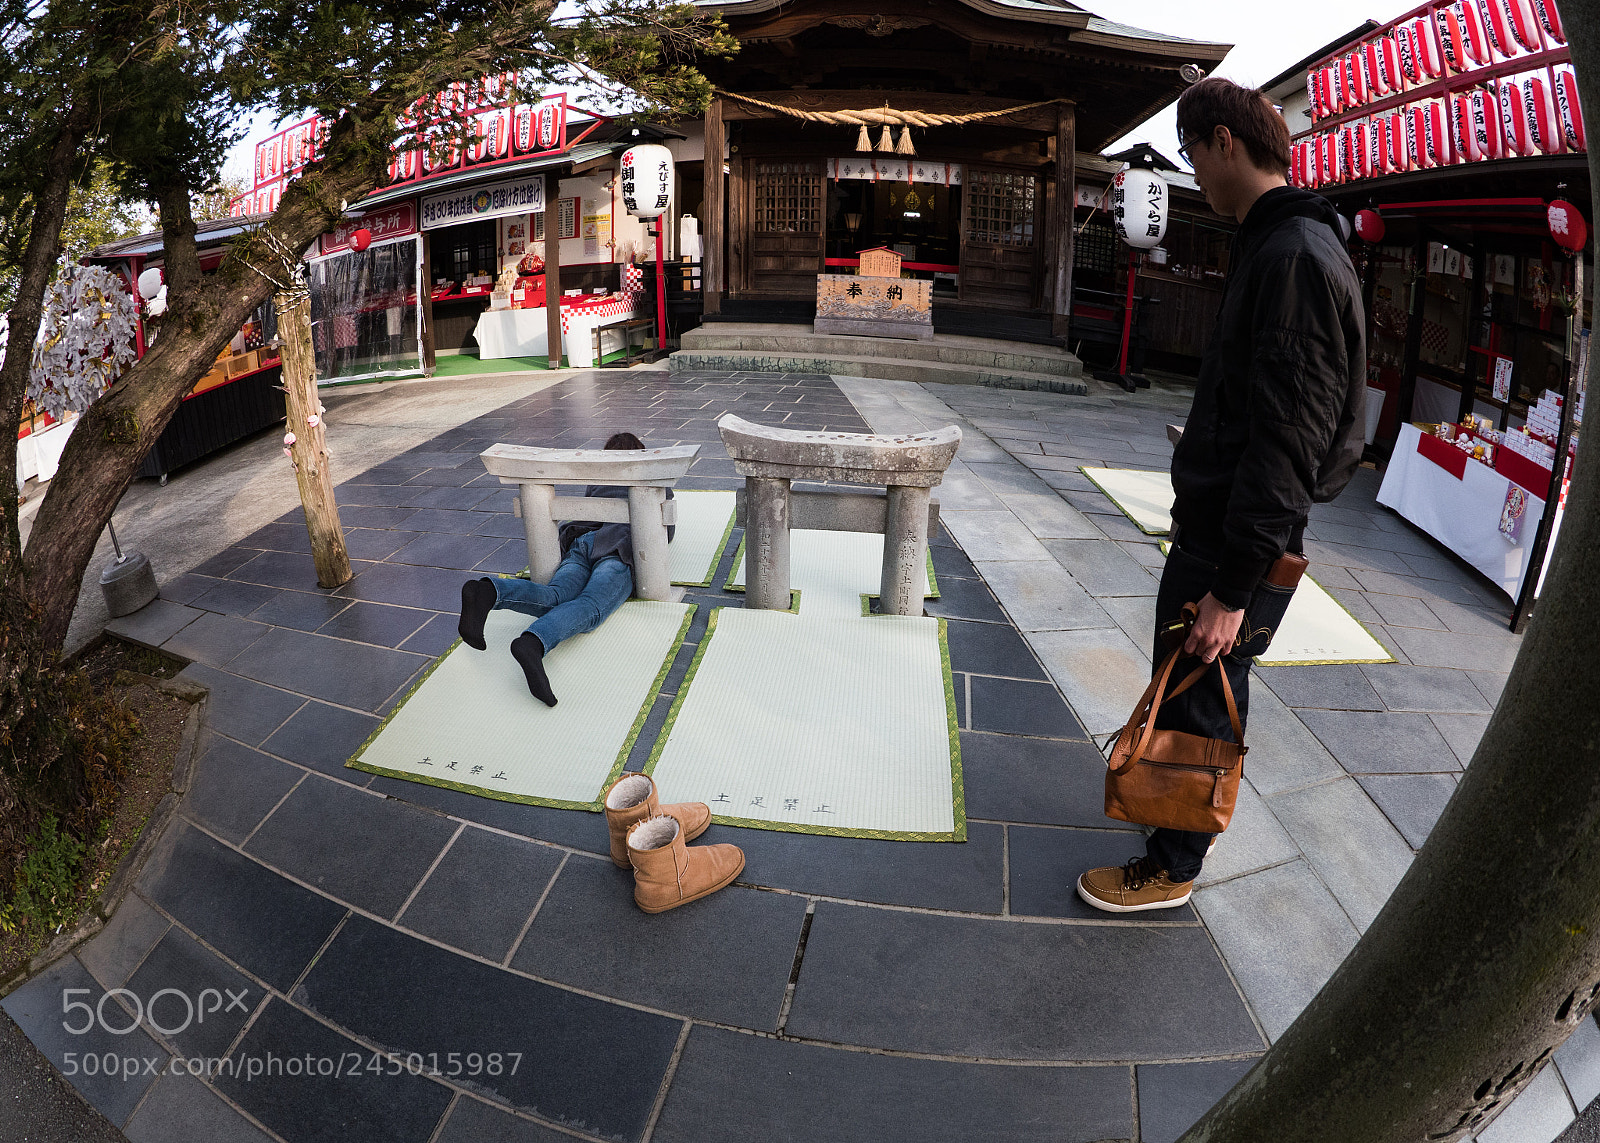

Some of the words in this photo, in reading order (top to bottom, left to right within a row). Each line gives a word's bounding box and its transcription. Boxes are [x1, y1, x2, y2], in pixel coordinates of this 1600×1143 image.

[654, 160, 669, 209] えびす屋
[1146, 181, 1162, 238] かぐら屋
[417, 756, 508, 781] 土足禁止
[711, 792, 836, 815] 土足禁止
